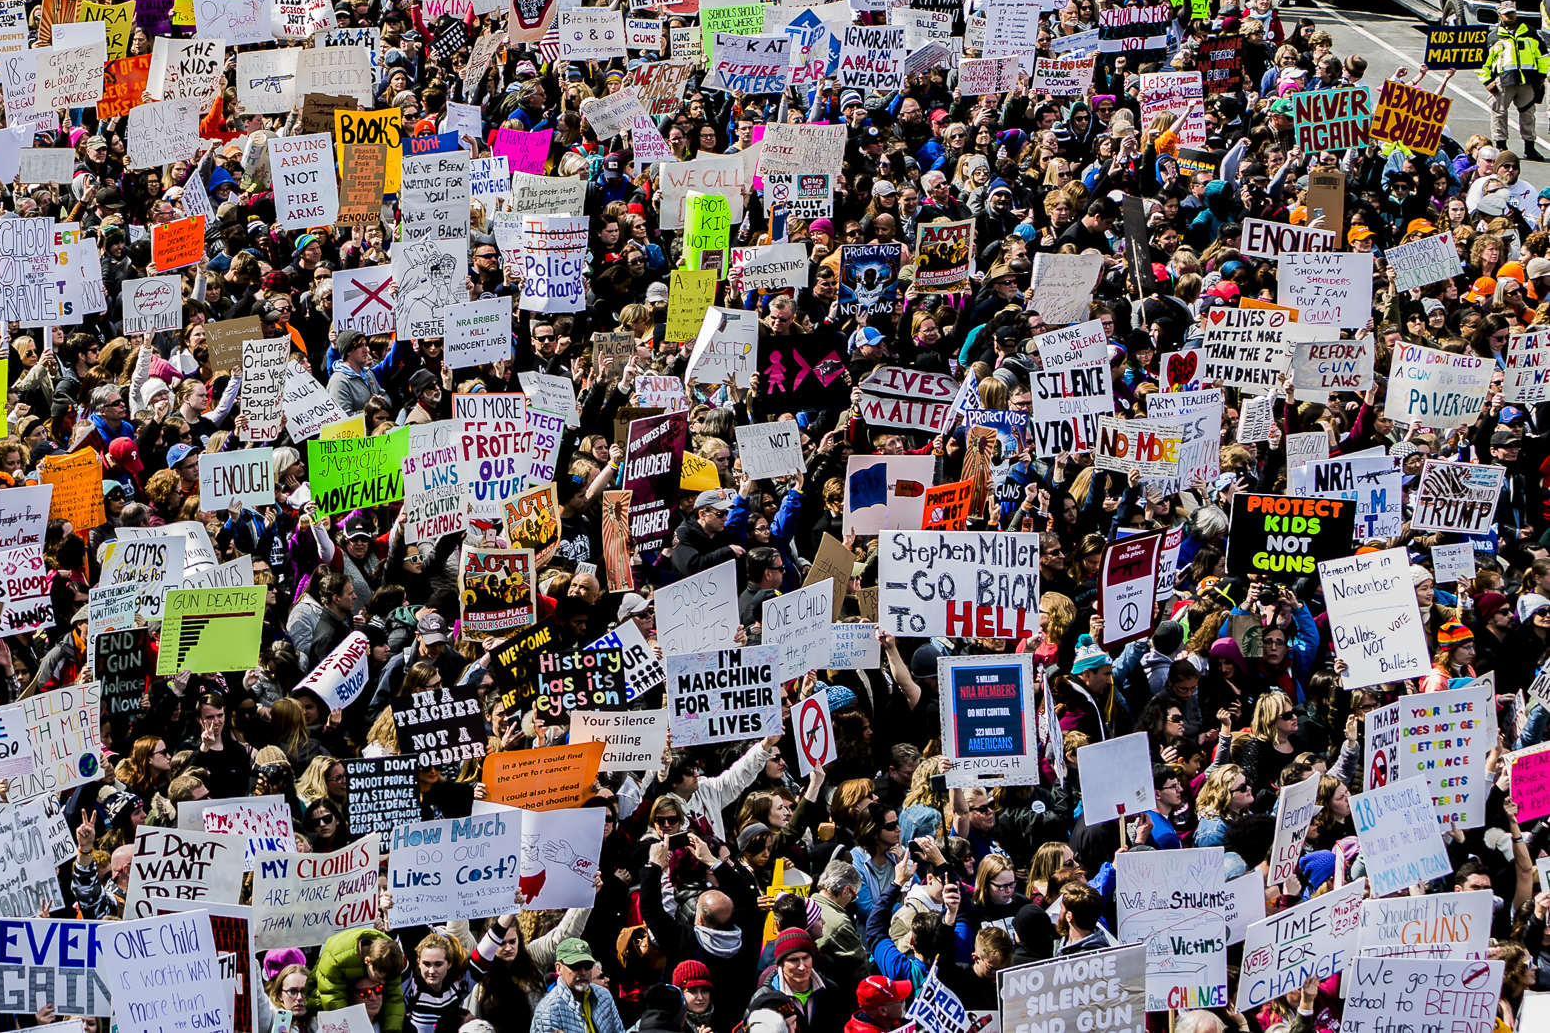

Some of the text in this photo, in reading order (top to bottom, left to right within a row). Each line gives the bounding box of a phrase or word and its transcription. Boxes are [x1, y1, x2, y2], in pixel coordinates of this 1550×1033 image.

[844, 27, 906, 49] IGNORANCE
[1430, 30, 1488, 44] KIDS LIVES
[1429, 46, 1482, 64] MATTER
[842, 70, 904, 89] WEAPON
[1297, 92, 1367, 121] NEVER
[1382, 81, 1450, 120] BROKEN
[340, 113, 401, 149] BOOKS
[1299, 117, 1367, 150] AGAIN
[273, 140, 326, 153] LOVING
[280, 153, 319, 164] ARMS
[284, 171, 318, 184] NOT
[288, 192, 318, 204] FIRE
[288, 207, 325, 218] ARMS
[1248, 223, 1337, 254] ENOUGH
[456, 314, 498, 328] NRA BRIBES
[469, 328, 484, 337] KILL
[450, 338, 506, 352] INNOCENT LIVES
[1310, 345, 1365, 360] REFORM
[1319, 362, 1355, 376] GUN
[1323, 374, 1359, 387] LAWS
[630, 454, 670, 479] LOUDER!
[1249, 497, 1342, 515] PROTECT
[1420, 496, 1491, 529] TRUMP
[632, 510, 668, 533] HIGHER
[1265, 515, 1319, 534] KIDS
[893, 533, 1037, 568] Stephen Miller
[1268, 537, 1310, 552] NOT
[1253, 553, 1315, 573] GUNS
[977, 570, 1036, 606] BACK
[946, 600, 1031, 636] HELL
[540, 653, 623, 680] History
[718, 649, 743, 669] I'M
[537, 670, 615, 695] has its
[677, 666, 771, 694] MARCHING
[960, 683, 1017, 698] NRA MEMBERS
[536, 690, 620, 717] eyes on
[675, 688, 774, 716] FOR THEIR
[1412, 703, 1474, 718] YOUR LIFE
[394, 700, 480, 726] TEACHER
[583, 716, 655, 728] Your Silence
[708, 713, 762, 736] LIVES
[1403, 720, 1480, 735] DOES NOT GET
[605, 734, 641, 748] Killing
[968, 736, 1013, 750] AMERICANS
[1411, 737, 1470, 753] BETTER BY
[603, 750, 652, 762] Children
[1417, 756, 1470, 768] CHANCE
